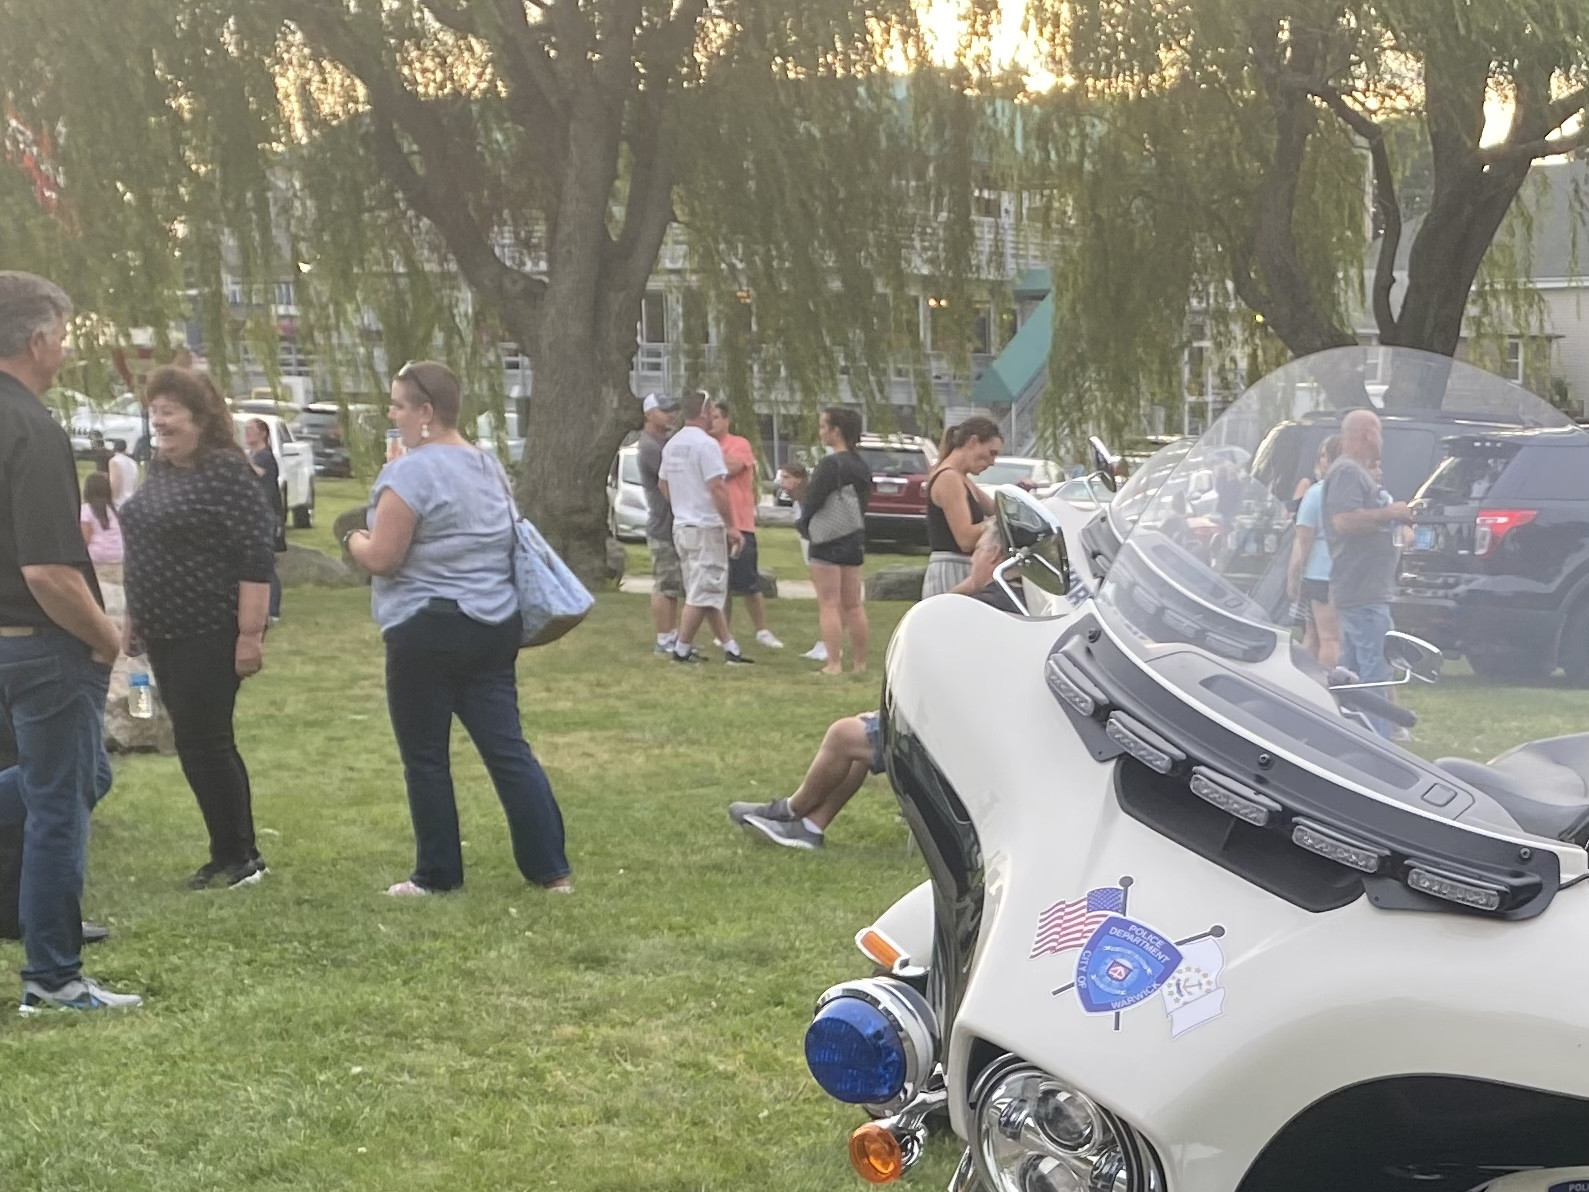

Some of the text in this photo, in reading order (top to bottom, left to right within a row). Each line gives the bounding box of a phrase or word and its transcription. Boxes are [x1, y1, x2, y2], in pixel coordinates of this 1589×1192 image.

[1108, 926, 1171, 963] DEPARTMENT
[1128, 924, 1166, 947] POLICE
[1078, 950, 1092, 988] CITY OF
[1110, 981, 1161, 1009] WARWICK
